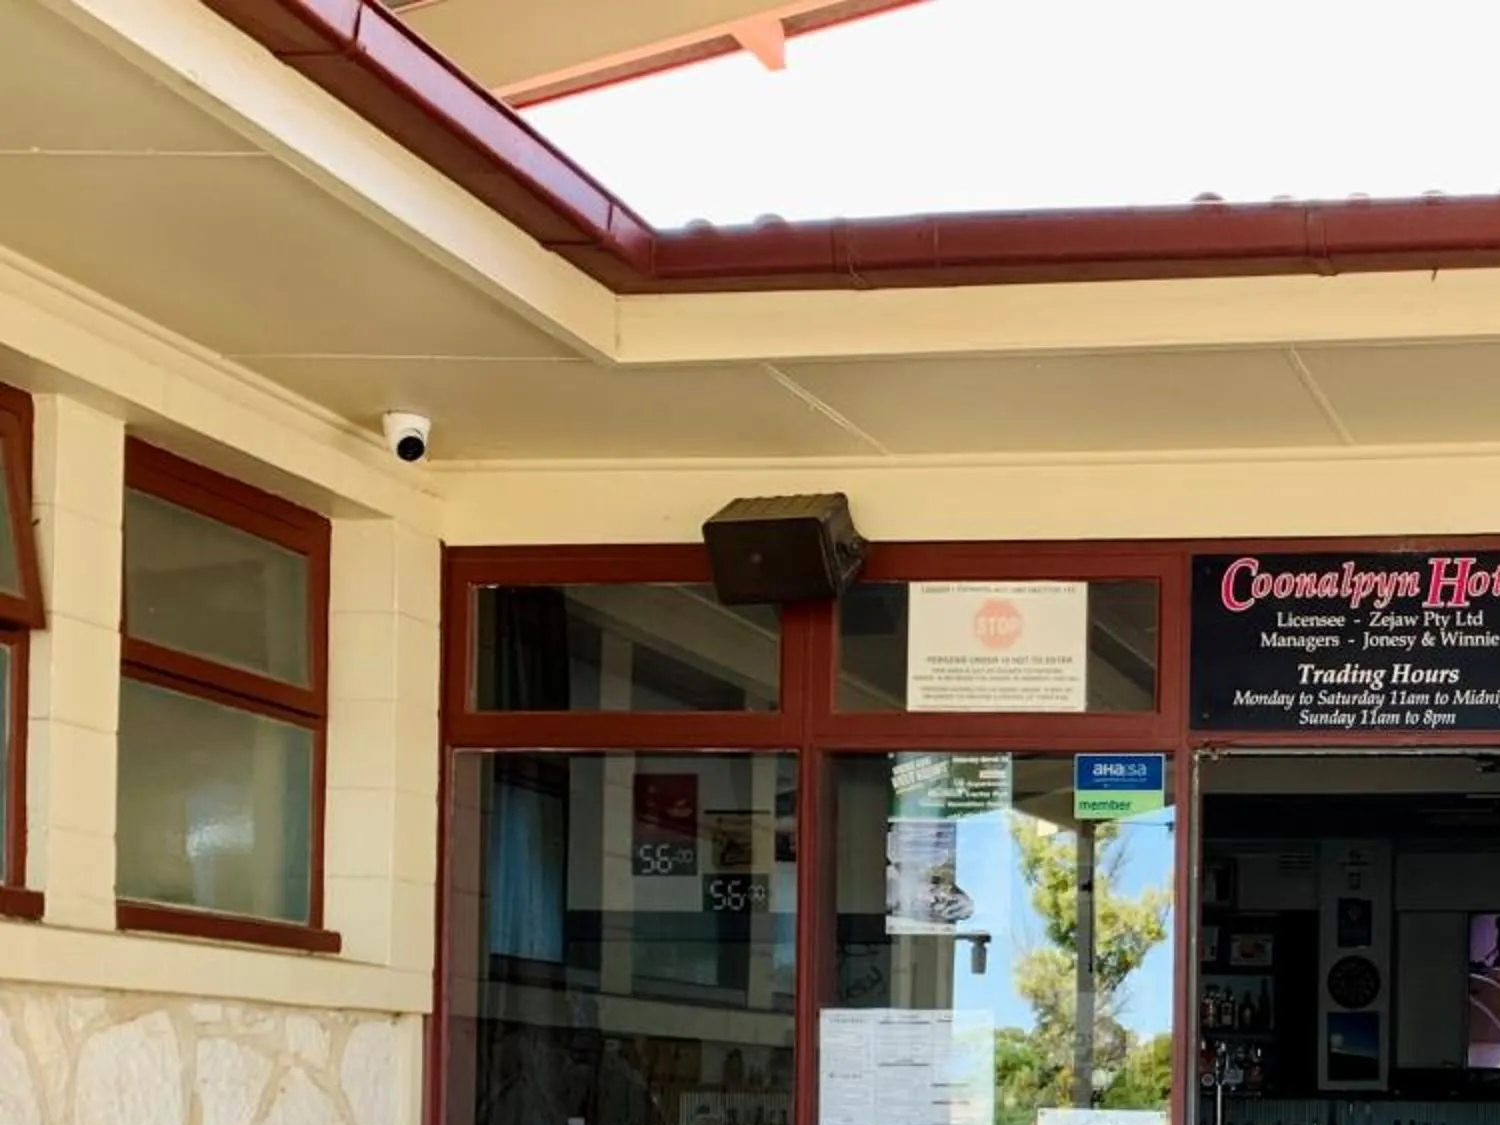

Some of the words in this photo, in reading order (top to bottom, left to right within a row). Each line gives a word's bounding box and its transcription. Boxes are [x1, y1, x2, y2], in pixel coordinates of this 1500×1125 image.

[1221, 557, 1420, 612] Coonalpyn
[976, 616, 1020, 637] STOP
[1277, 611, 1346, 627] Licensee
[1369, 611, 1419, 631] Zejaw
[1423, 611, 1450, 629] Pty
[1455, 610, 1484, 627] Ltd
[1260, 632, 1340, 652] Managers
[1362, 631, 1416, 651] Jonesy
[1421, 631, 1436, 647] &
[1440, 630, 1500, 647] Winnie
[1297, 663, 1387, 690] Trading
[1390, 663, 1460, 684] Hours
[1233, 689, 1295, 711] Monday
[1299, 691, 1313, 705] to
[1317, 689, 1386, 711] Saturday
[1389, 690, 1430, 705] 11am
[1433, 691, 1449, 705] to
[1298, 709, 1356, 729] Sunday
[1360, 709, 1400, 725] 11am
[1405, 711, 1420, 725] to
[1423, 709, 1457, 729] 8pm
